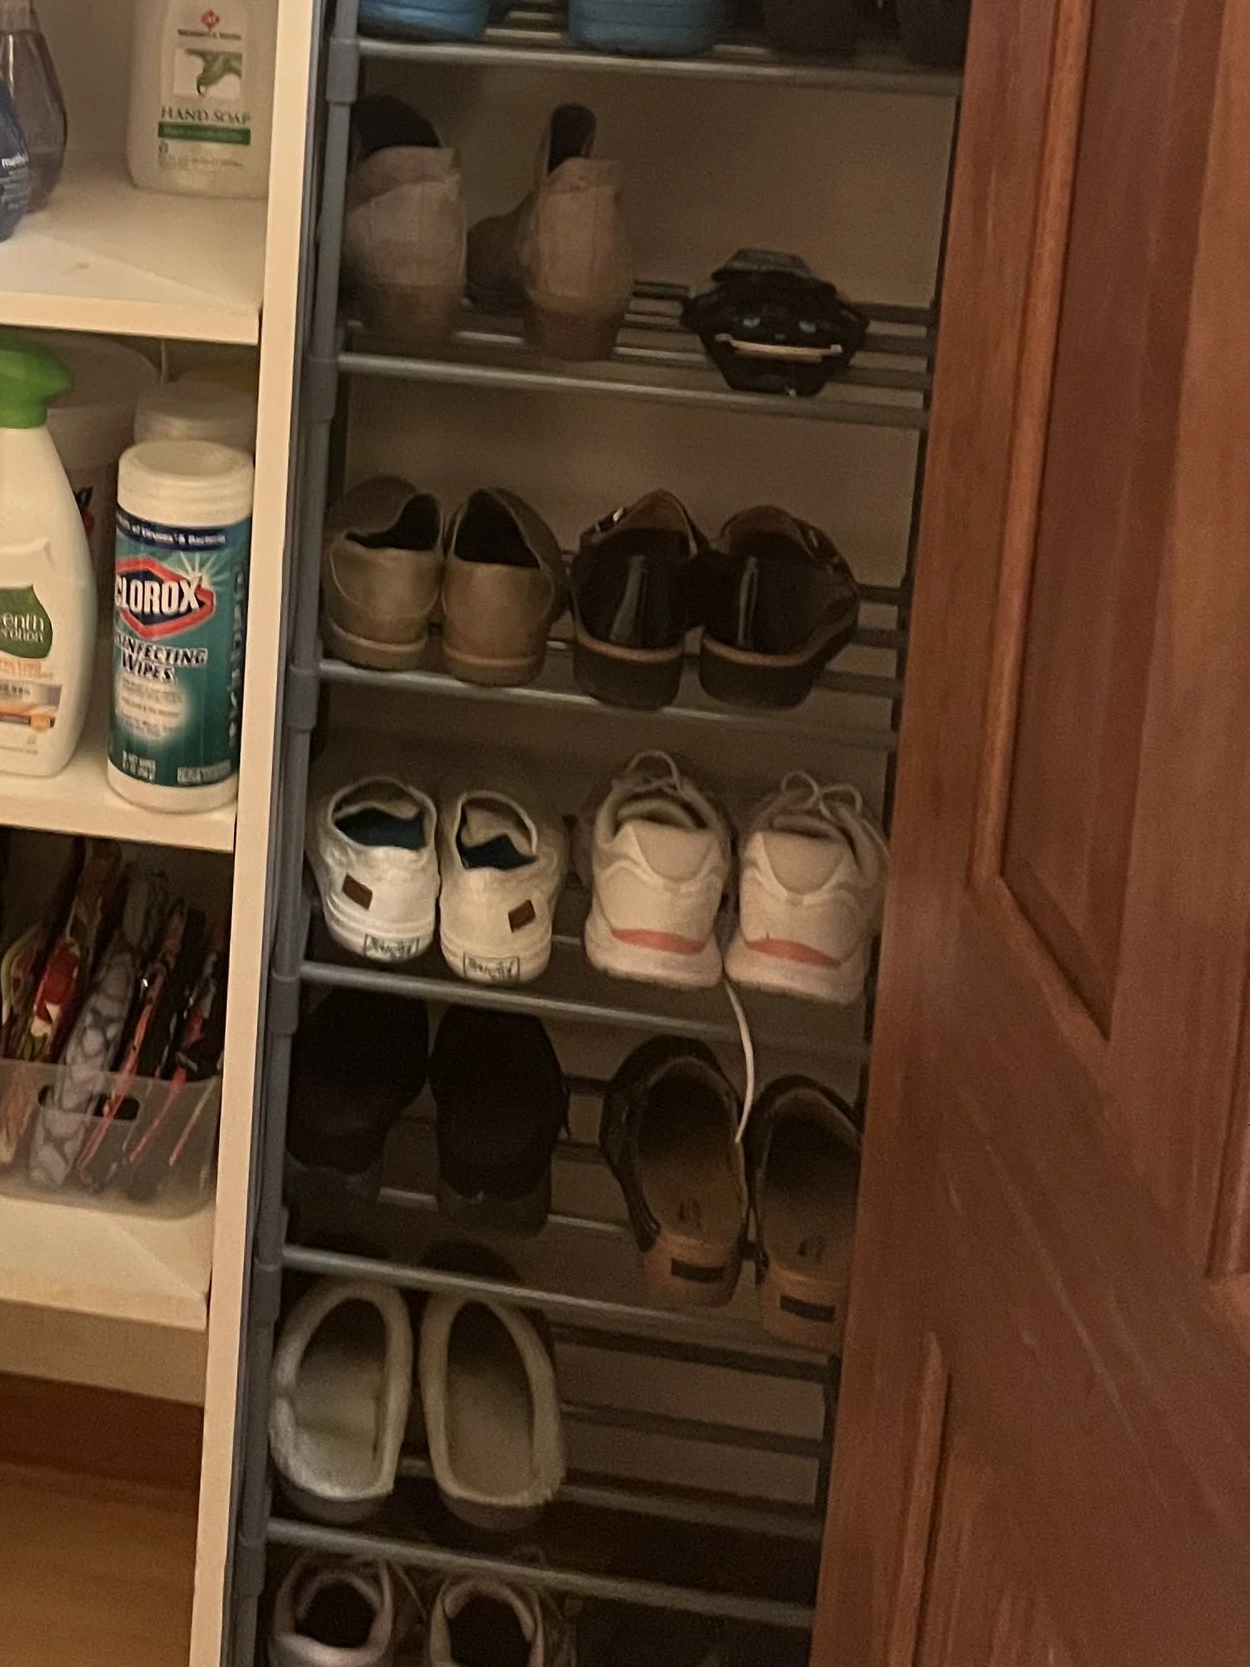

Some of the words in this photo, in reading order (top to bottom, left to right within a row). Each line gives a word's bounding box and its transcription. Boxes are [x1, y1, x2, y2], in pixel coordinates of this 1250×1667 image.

[161, 106, 210, 122] HAND
[212, 110, 251, 125] SOAP
[114, 573, 201, 615] CLOROX
[122, 649, 175, 681] WIPES
